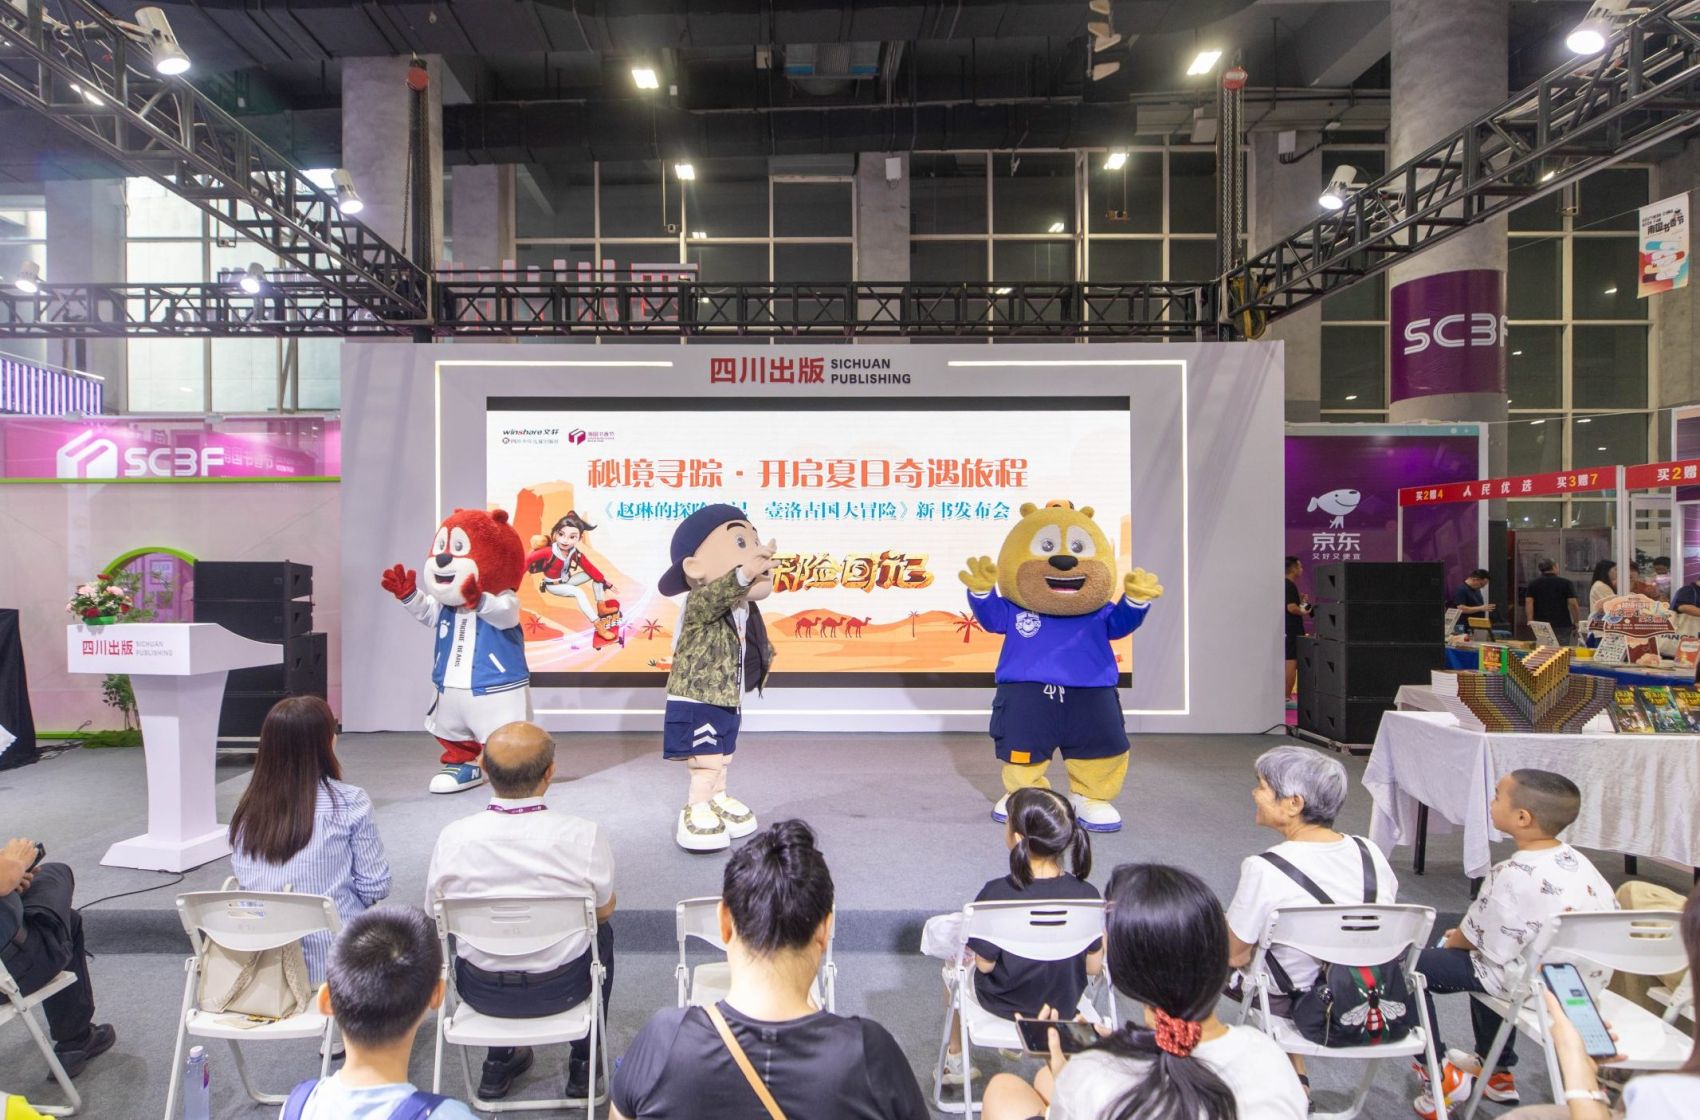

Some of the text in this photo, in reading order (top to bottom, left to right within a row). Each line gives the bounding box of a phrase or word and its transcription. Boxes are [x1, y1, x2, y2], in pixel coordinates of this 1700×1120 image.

[710, 357, 825, 384] 四川出版
[831, 359, 890, 369] SICHUAN
[831, 373, 911, 384] PUBLISHING
[1415, 473, 1598, 501] 买2赠4 人民优选 买3赠7
[1312, 532, 1361, 552] 京东
[1312, 552, 1361, 561] 又好又便宜
[82, 640, 134, 656] 四川出版
